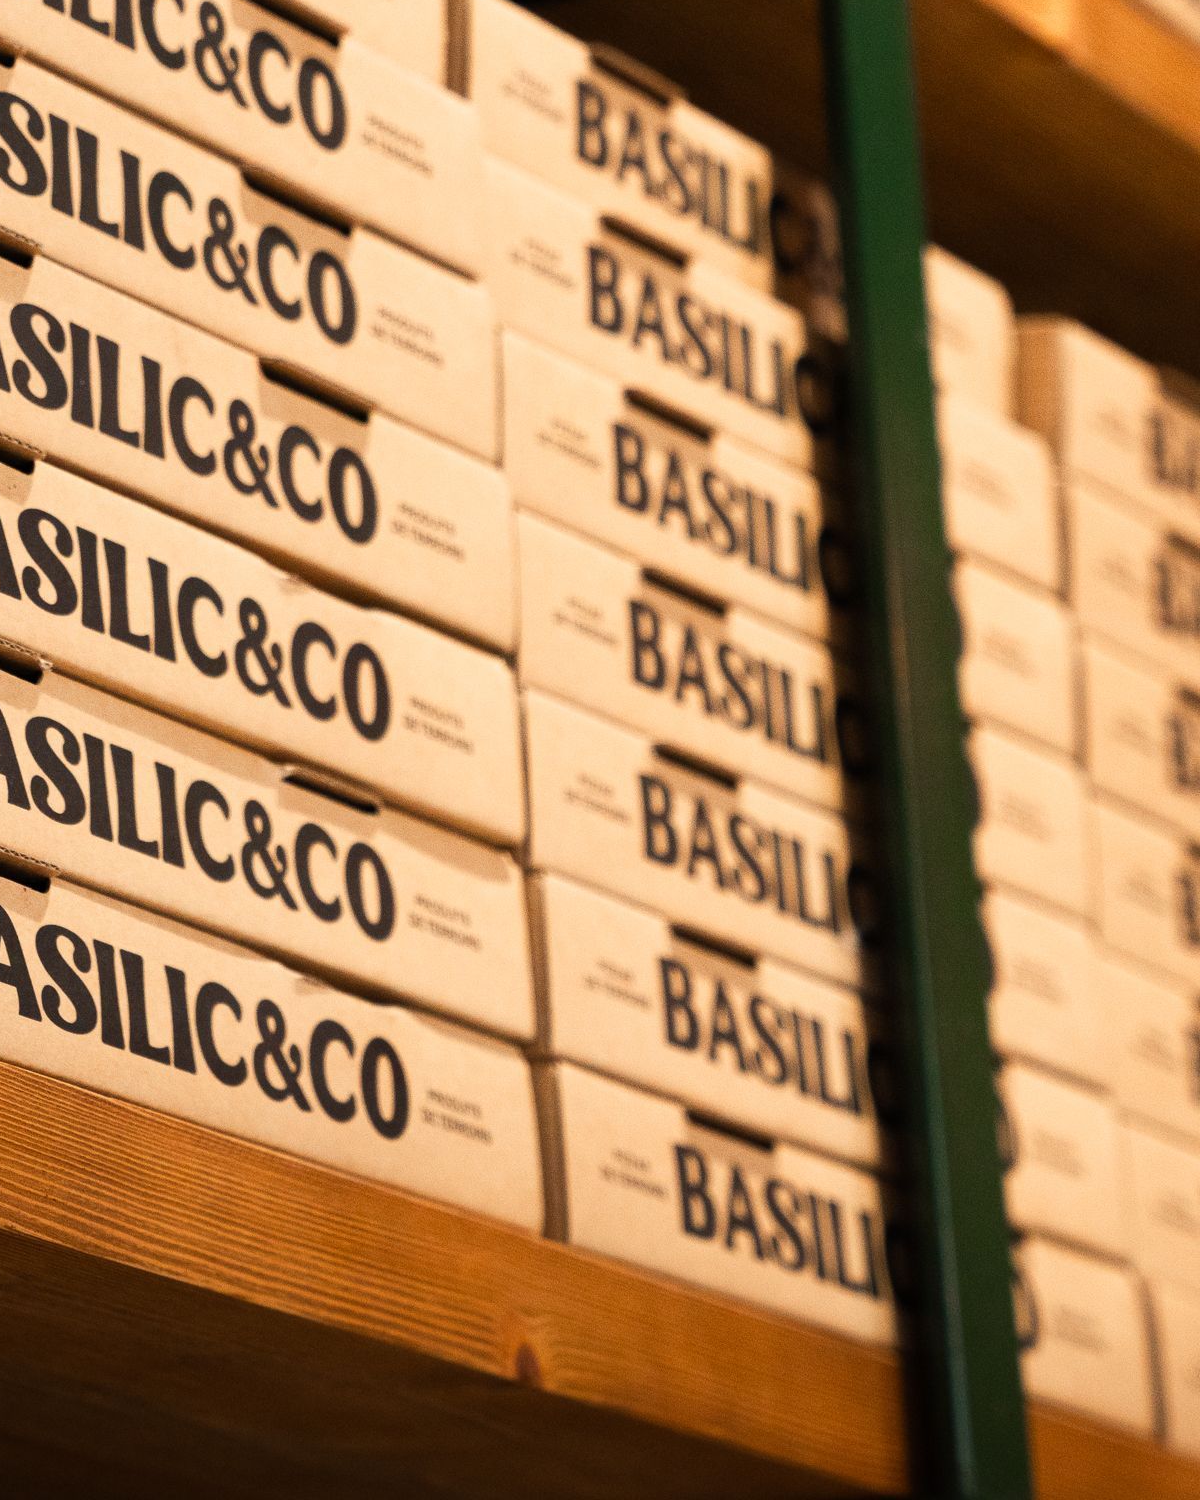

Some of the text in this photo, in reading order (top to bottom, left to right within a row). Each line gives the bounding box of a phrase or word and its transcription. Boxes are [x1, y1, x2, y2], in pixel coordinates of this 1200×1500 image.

[639, 774, 858, 945] BASILI
[660, 958, 870, 1125] BASILI
[675, 1144, 885, 1305] BASILI
